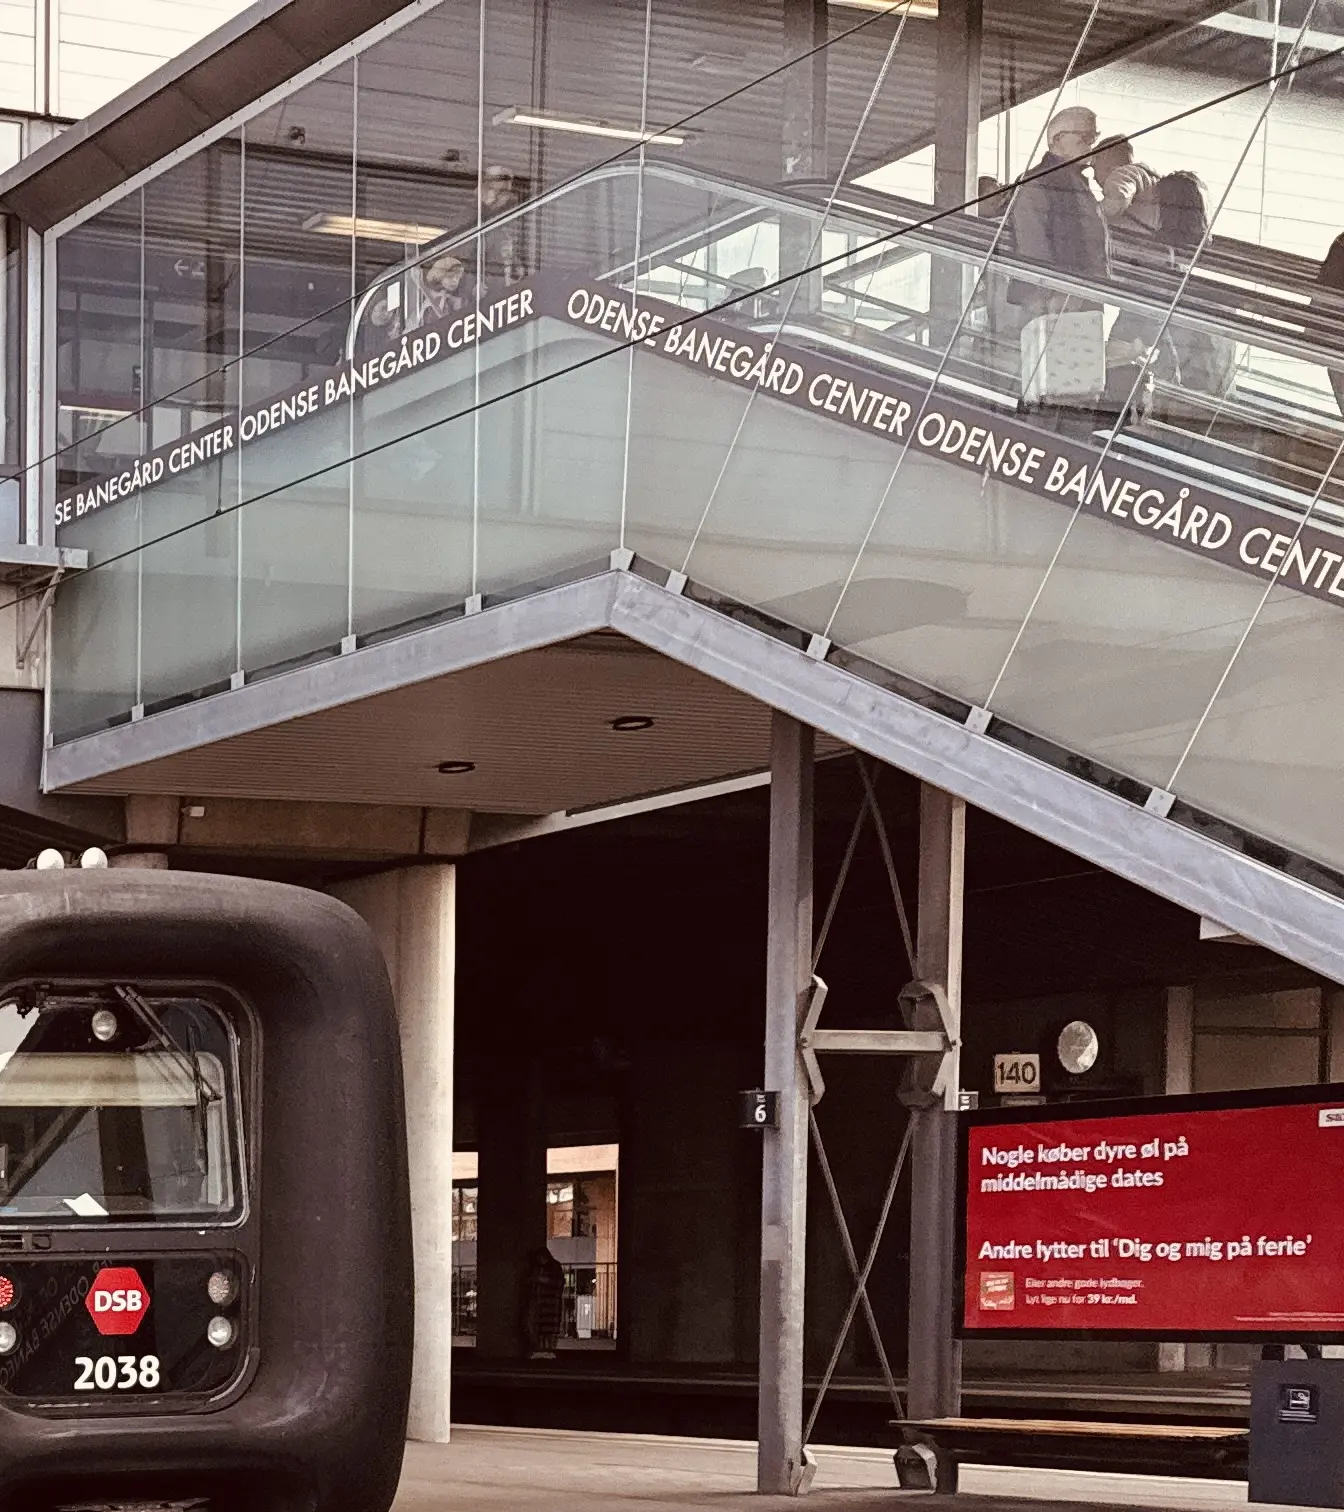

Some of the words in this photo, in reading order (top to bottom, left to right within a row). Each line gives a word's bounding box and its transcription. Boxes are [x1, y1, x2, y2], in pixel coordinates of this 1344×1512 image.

[76, 459, 164, 517] BANEGÅRD
[168, 425, 234, 473] CENTER
[240, 386, 319, 442] ODENSE
[325, 336, 441, 403] BANEGÅRD
[447, 289, 534, 348] CENTER
[567, 289, 664, 347] ODENSE
[664, 325, 804, 395] BANEGÅRD
[808, 374, 911, 436] CENTER
[918, 413, 1045, 484] ODENSE
[1044, 457, 1233, 549] BANEGÅRD
[998, 1062, 1036, 1084] 140
[755, 1104, 766, 1122] 6
[982, 1147, 1034, 1168] Nogle
[1038, 1143, 1091, 1163] køber
[1094, 1141, 1137, 1163] dyre
[1141, 1138, 1160, 1158] øl
[1164, 1136, 1189, 1160] på
[981, 1170, 1108, 1192] middelmådige
[1111, 1168, 1164, 1188] dates
[978, 1240, 1033, 1259] Andre
[1036, 1240, 1087, 1262] lytter
[1090, 1239, 1109, 1258] til
[1155, 1242, 1182, 1262] og
[1185, 1237, 1223, 1261] mig
[1227, 1235, 1252, 1260] på
[94, 1290, 143, 1311] DSB
[1087, 1294, 1100, 1304] 39
[74, 1355, 160, 1390] 2038
